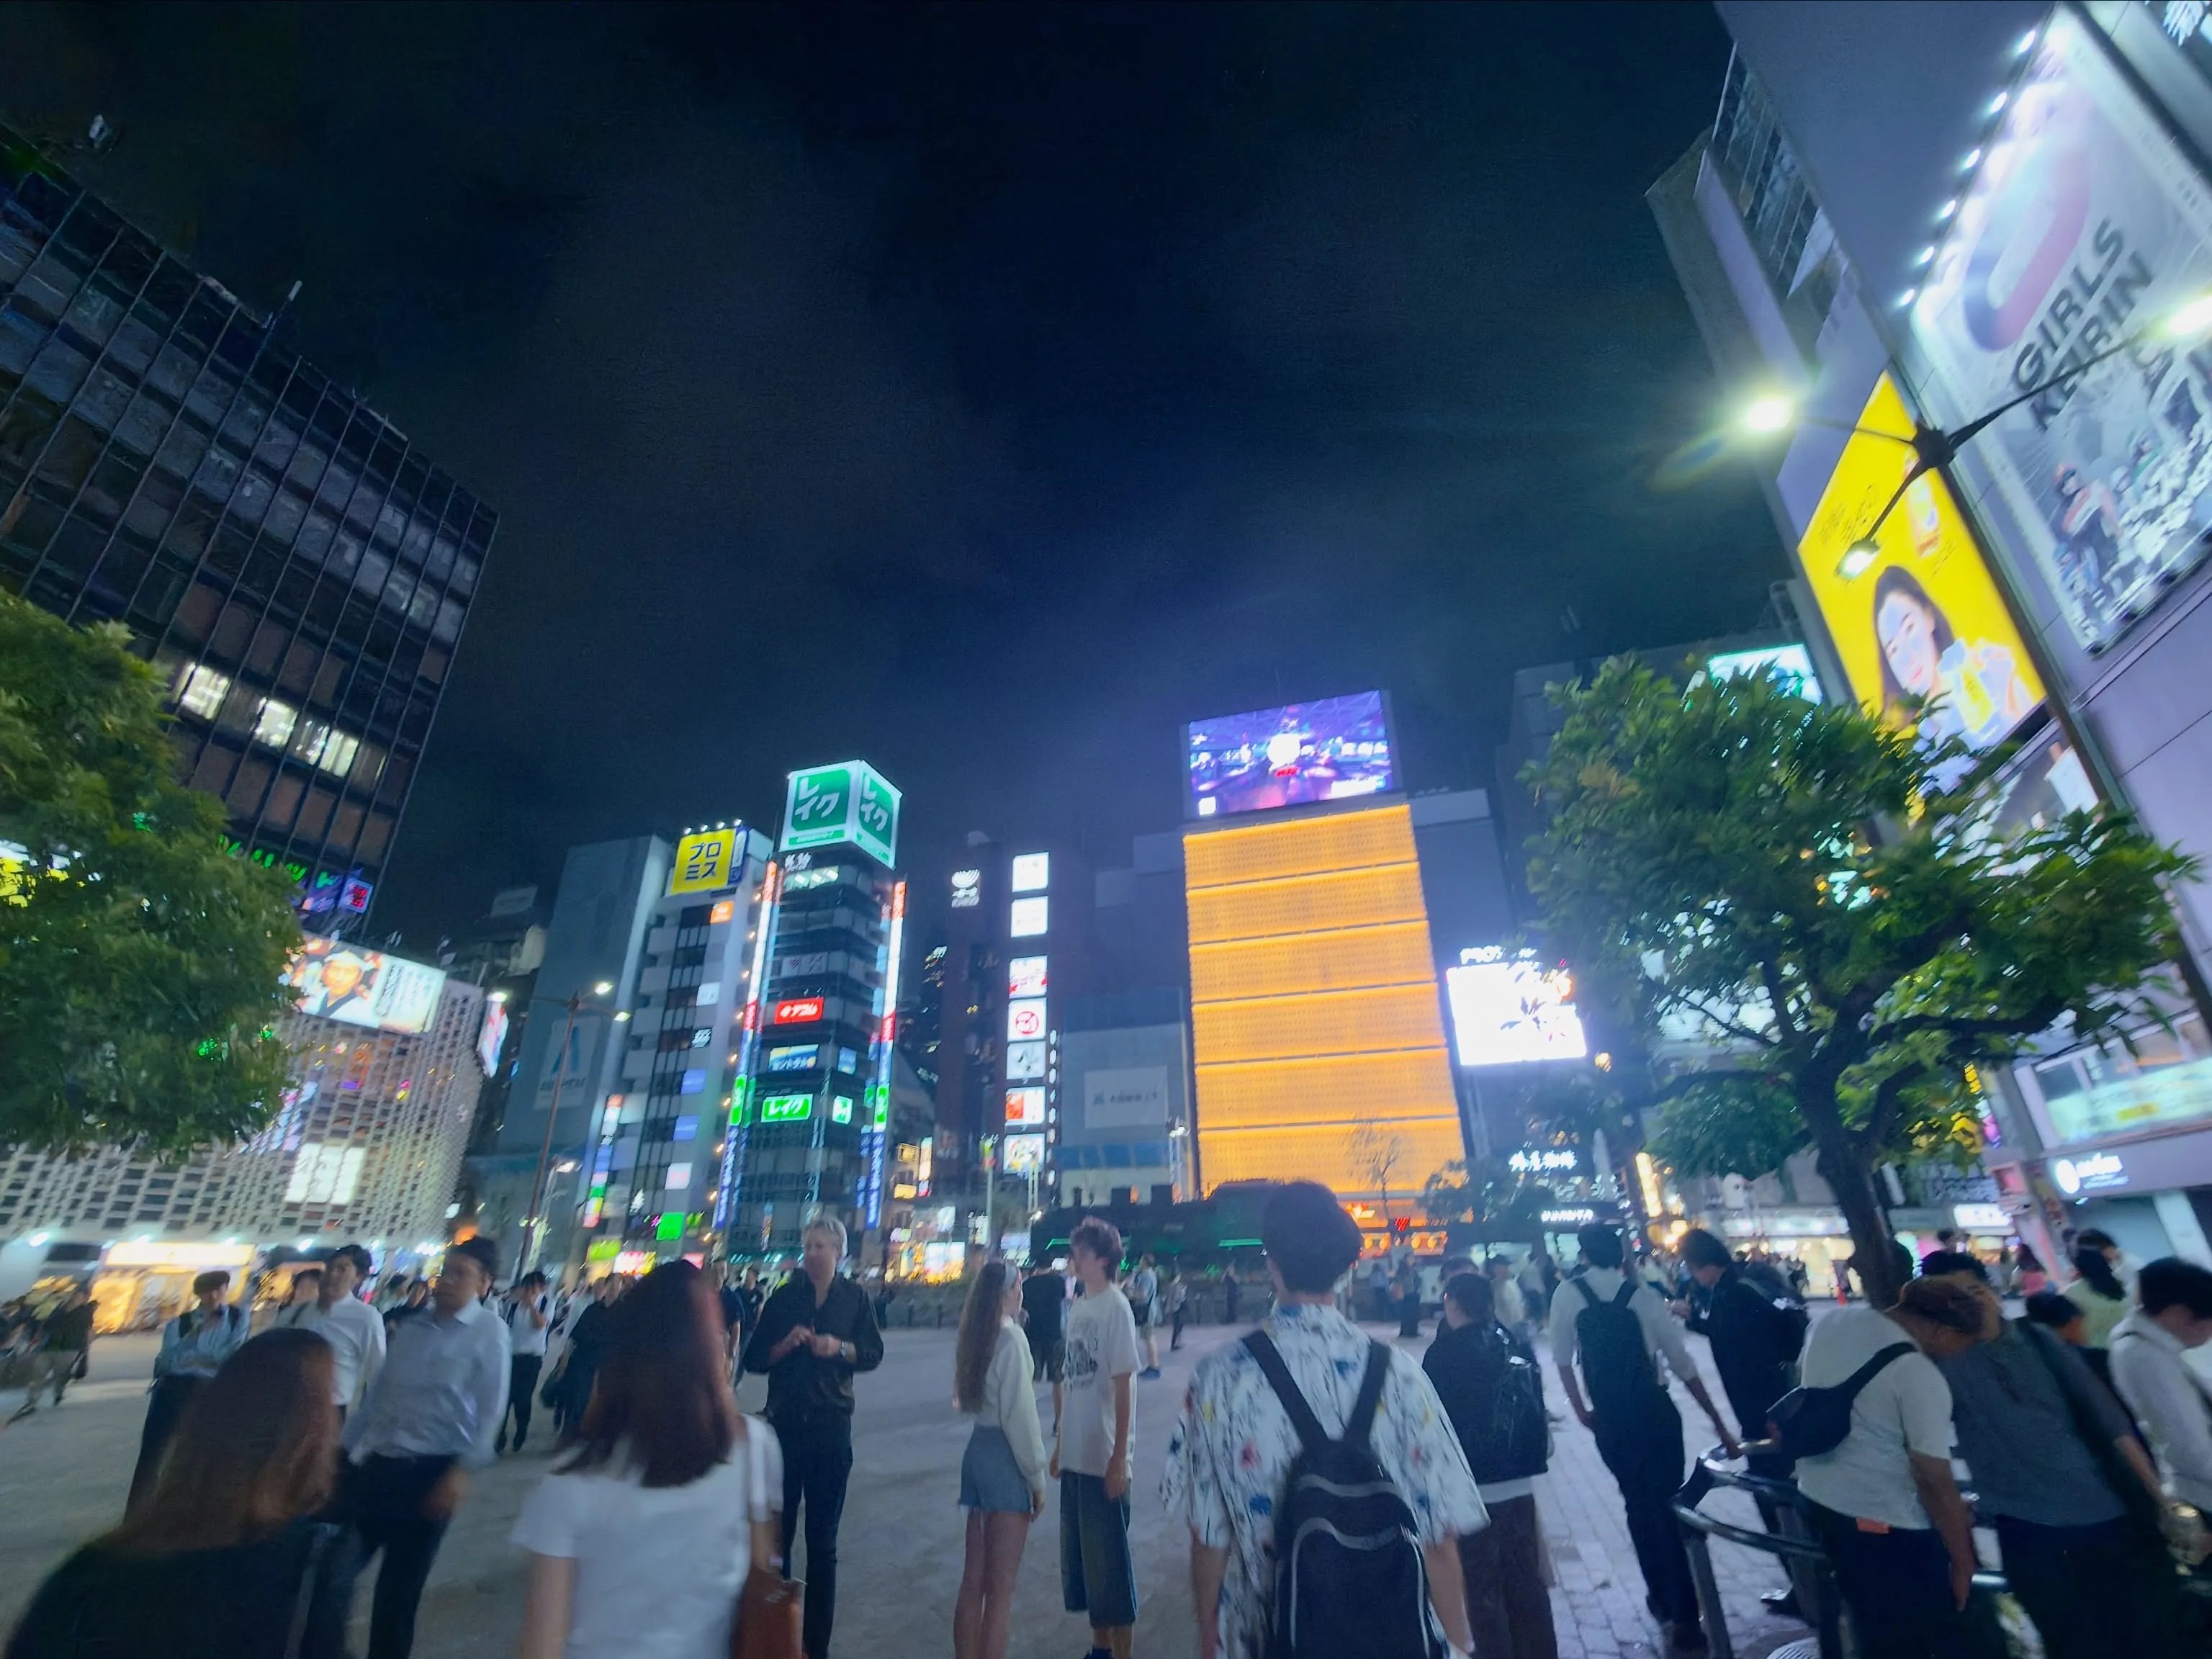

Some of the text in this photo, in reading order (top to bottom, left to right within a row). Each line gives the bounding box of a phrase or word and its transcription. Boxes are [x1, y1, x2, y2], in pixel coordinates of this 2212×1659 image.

[2014, 218, 2123, 390] GIRLS
[795, 777, 840, 821] レイク
[860, 775, 889, 831] レイク
[768, 1097, 804, 1115] レイク
